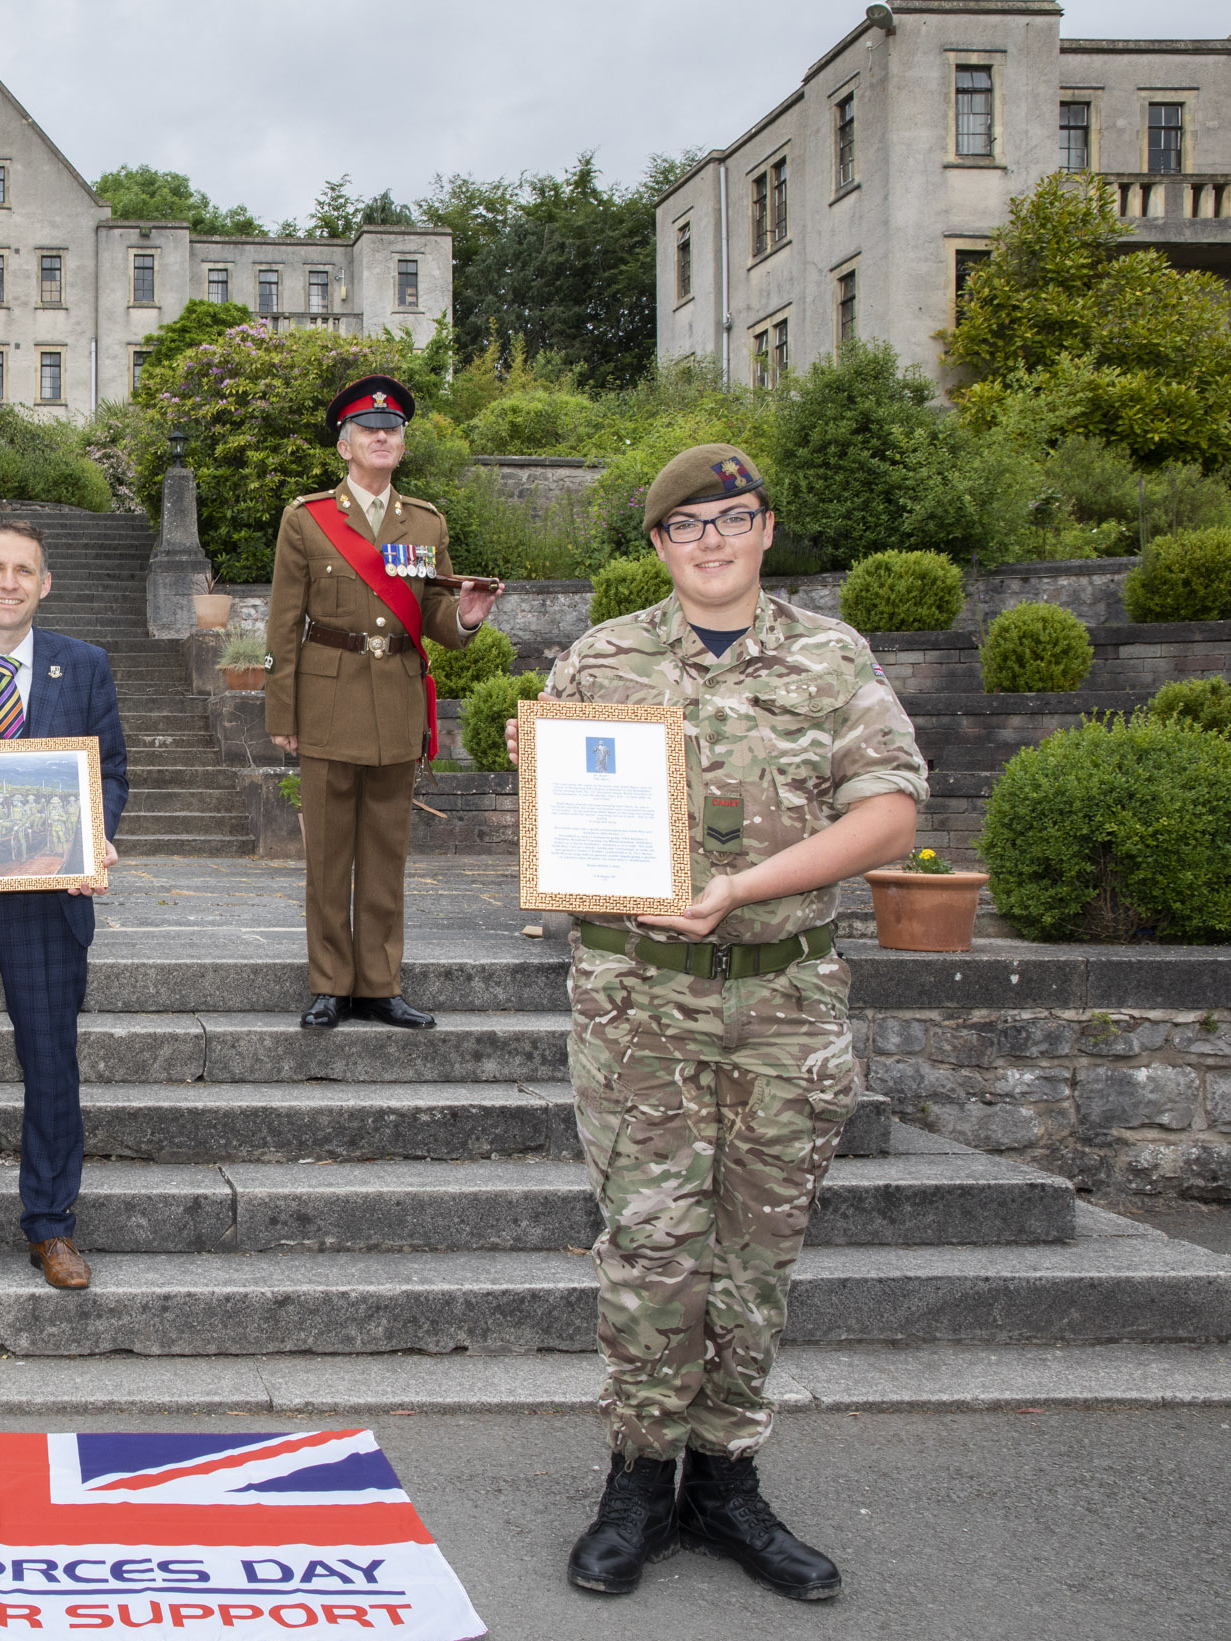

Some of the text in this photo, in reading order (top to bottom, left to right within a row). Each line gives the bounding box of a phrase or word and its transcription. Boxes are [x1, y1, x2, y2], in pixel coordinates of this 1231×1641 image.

[713, 799, 740, 807] CADET
[241, 1559, 387, 1586] DAY
[65, 1600, 412, 1629] SUPPORT
